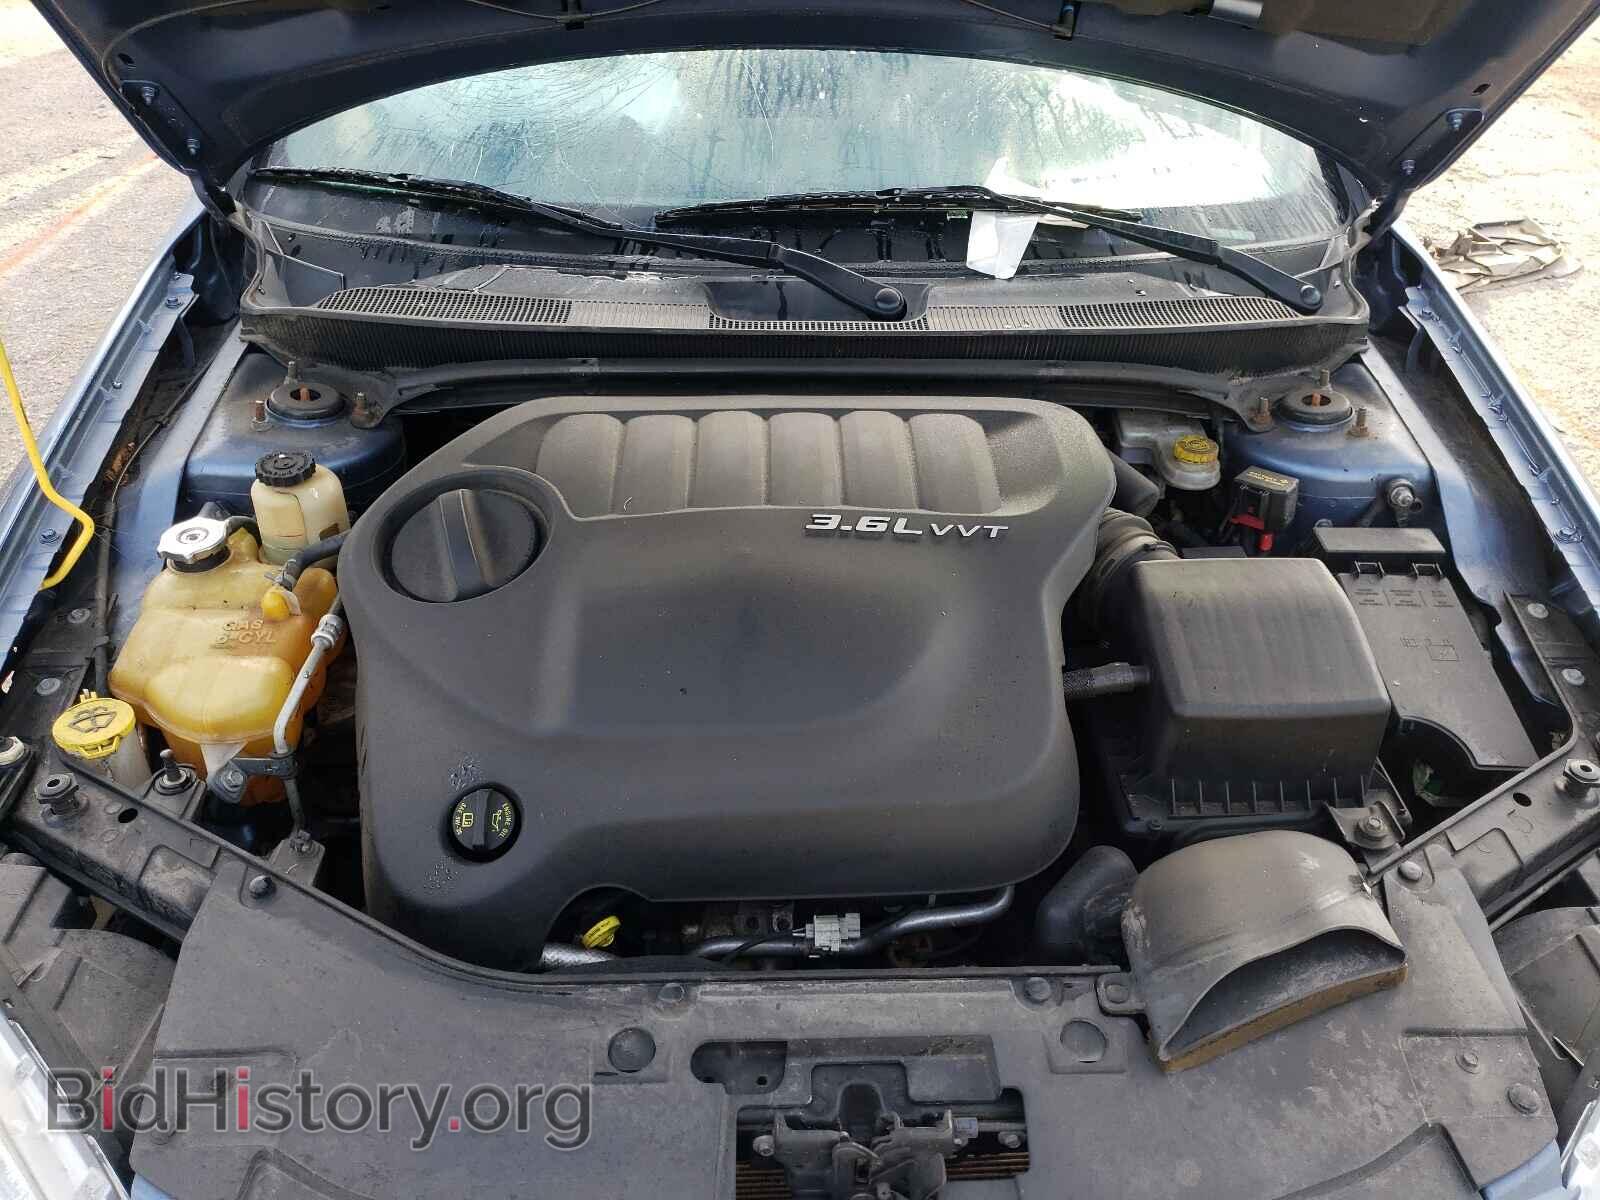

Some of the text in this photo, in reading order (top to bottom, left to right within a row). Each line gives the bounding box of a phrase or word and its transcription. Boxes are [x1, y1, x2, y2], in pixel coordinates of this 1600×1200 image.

[805, 513, 1009, 538] 3.6L VVT
[498, 802, 512, 840] ENGINE OIL
